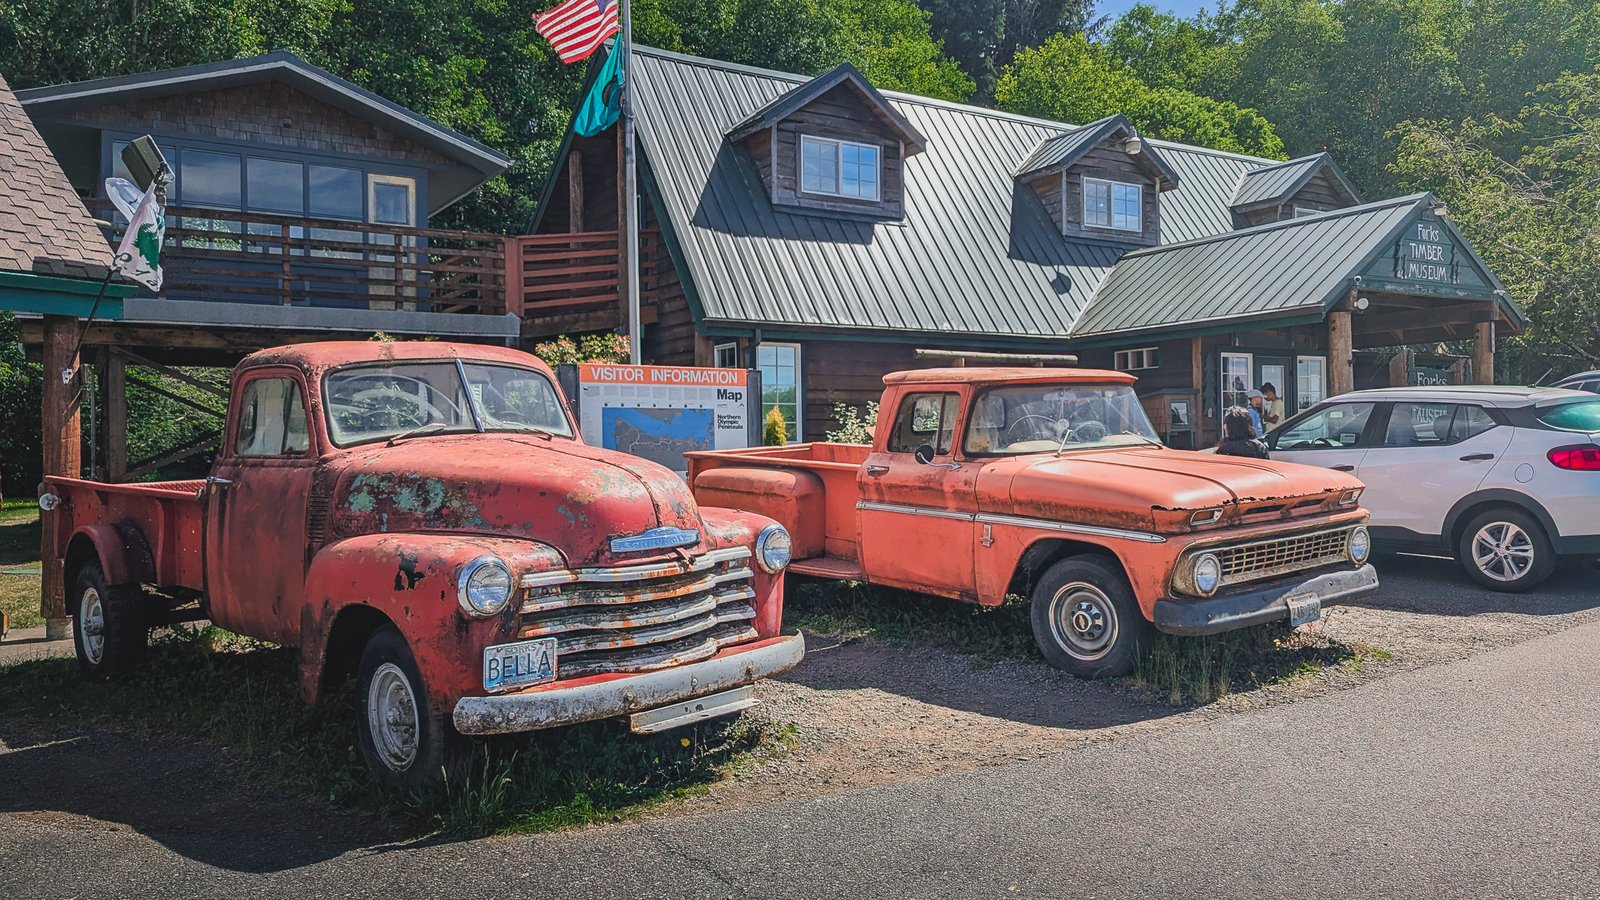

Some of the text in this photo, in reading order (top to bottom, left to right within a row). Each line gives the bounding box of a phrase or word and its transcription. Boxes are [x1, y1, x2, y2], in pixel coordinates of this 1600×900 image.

[1417, 223, 1439, 241] Forks
[1408, 263, 1447, 281] MUSEUM
[591, 367, 738, 384] VISITOR INFORMATION
[1416, 371, 1448, 387] Forks
[717, 388, 743, 402] Map
[505, 643, 538, 655] FORKS
[488, 650, 552, 682] BELLA
